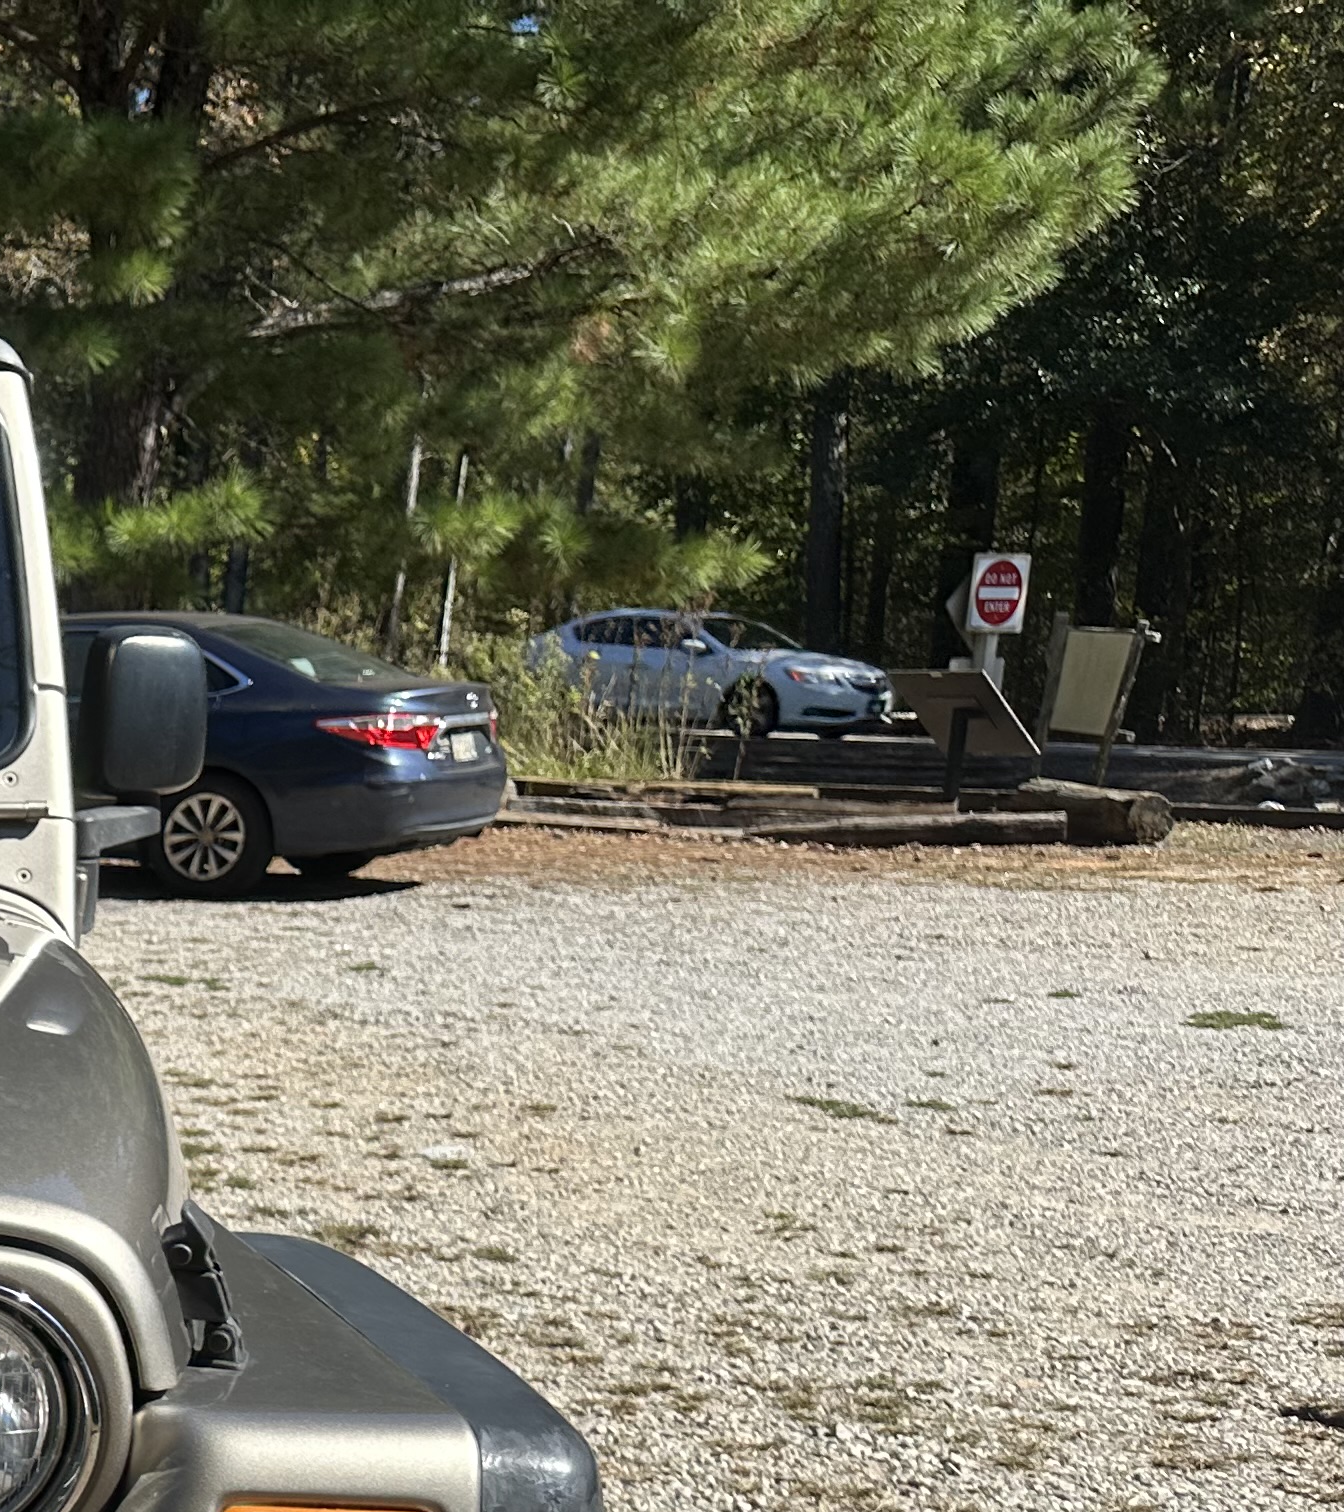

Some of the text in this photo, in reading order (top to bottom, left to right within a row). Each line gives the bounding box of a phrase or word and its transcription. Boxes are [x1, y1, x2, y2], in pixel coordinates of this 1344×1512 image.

[984, 572, 1018, 585] DO NOT
[984, 600, 1010, 613] ENTER
